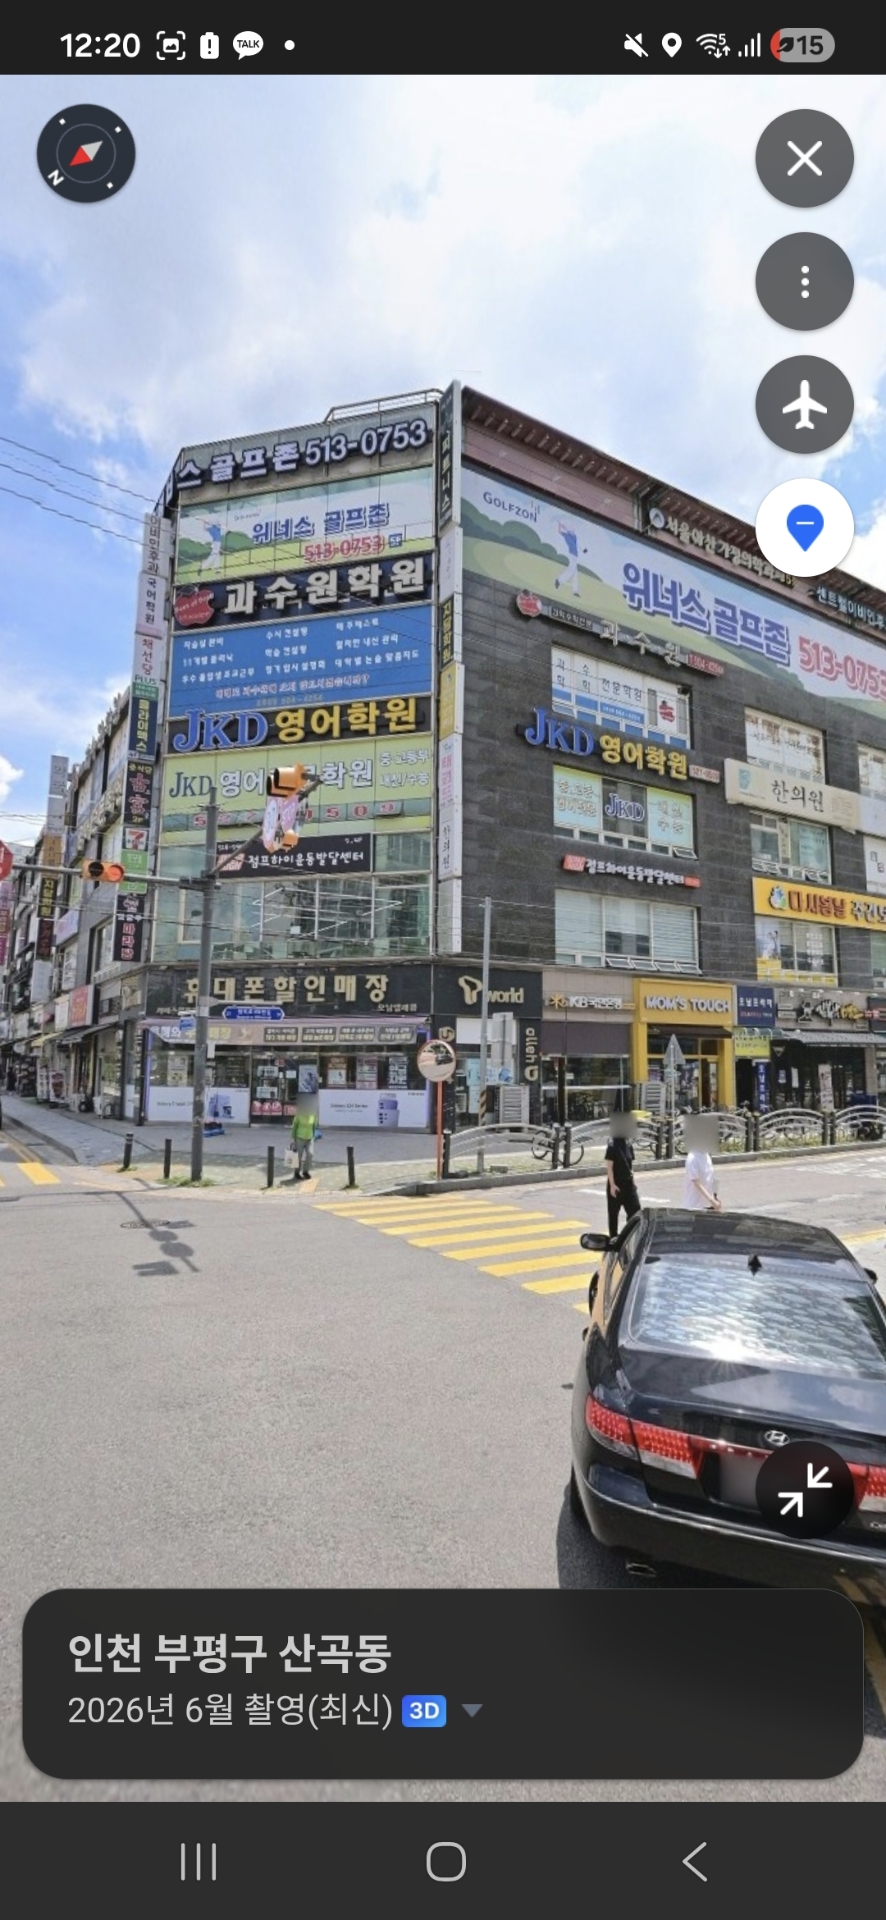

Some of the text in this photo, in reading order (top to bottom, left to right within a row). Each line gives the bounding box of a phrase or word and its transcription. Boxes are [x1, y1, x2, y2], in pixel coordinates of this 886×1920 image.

[210, 441, 299, 482] 골프존
[304, 420, 428, 467] 513-0753
[252, 504, 391, 545] 위너스 골프존
[482, 491, 538, 523] GOLFZON
[303, 534, 386, 563] 513-0753
[145, 577, 157, 625] 국어학원
[225, 557, 425, 615] 과수원학원
[601, 620, 681, 667] 과수원
[622, 562, 886, 699] 위너스 골프존 513-0753
[135, 673, 157, 686] PLUS
[136, 698, 150, 753] 클라이맥스
[173, 708, 268, 752] JKD
[275, 697, 418, 743] 영어학원
[525, 707, 595, 757] JKD
[600, 735, 689, 780] 영어학원
[169, 772, 214, 798] JKD
[771, 780, 824, 812] 한의원
[605, 793, 645, 822] JKD
[121, 922, 136, 960] 마라탕
[486, 987, 524, 1004] world
[645, 995, 730, 1013] MOM'S TOUCH
